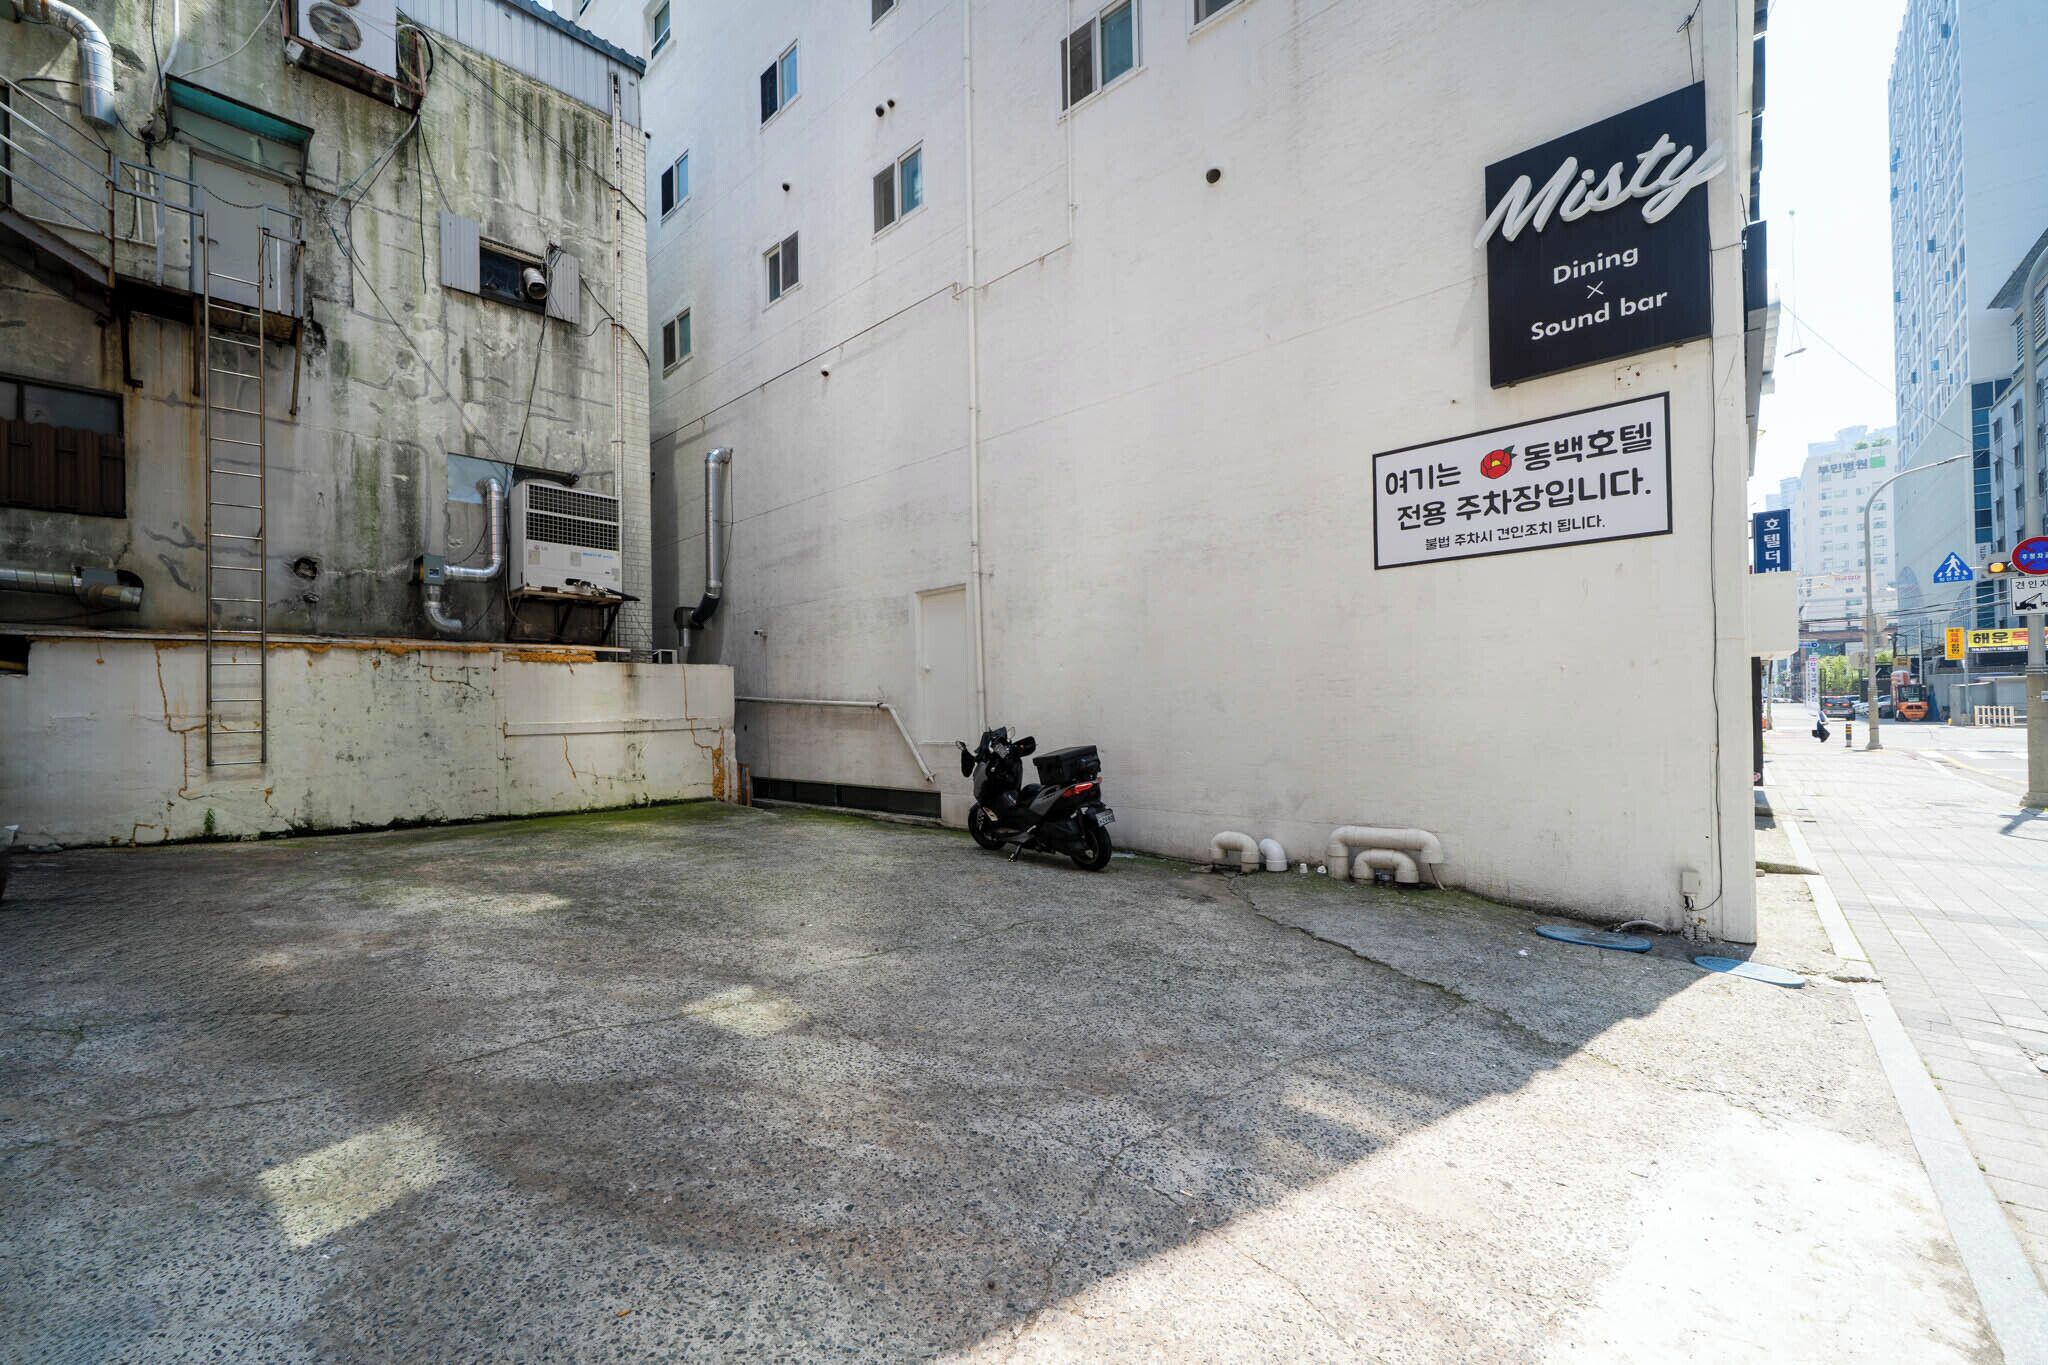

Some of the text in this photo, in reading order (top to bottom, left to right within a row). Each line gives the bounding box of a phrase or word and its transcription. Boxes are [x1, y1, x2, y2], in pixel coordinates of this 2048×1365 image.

[1474, 133, 1730, 249] Misty
[1553, 247, 1639, 285] Dining
[1531, 292, 1668, 341] Sound bar
[1385, 422, 1652, 495] 여기는 동백호텔
[1397, 467, 1652, 531] 전용 주차장입니다.
[1425, 536, 1451, 551] 불법
[1454, 530, 1493, 547] 주차시
[1496, 521, 1552, 541] 견인조치
